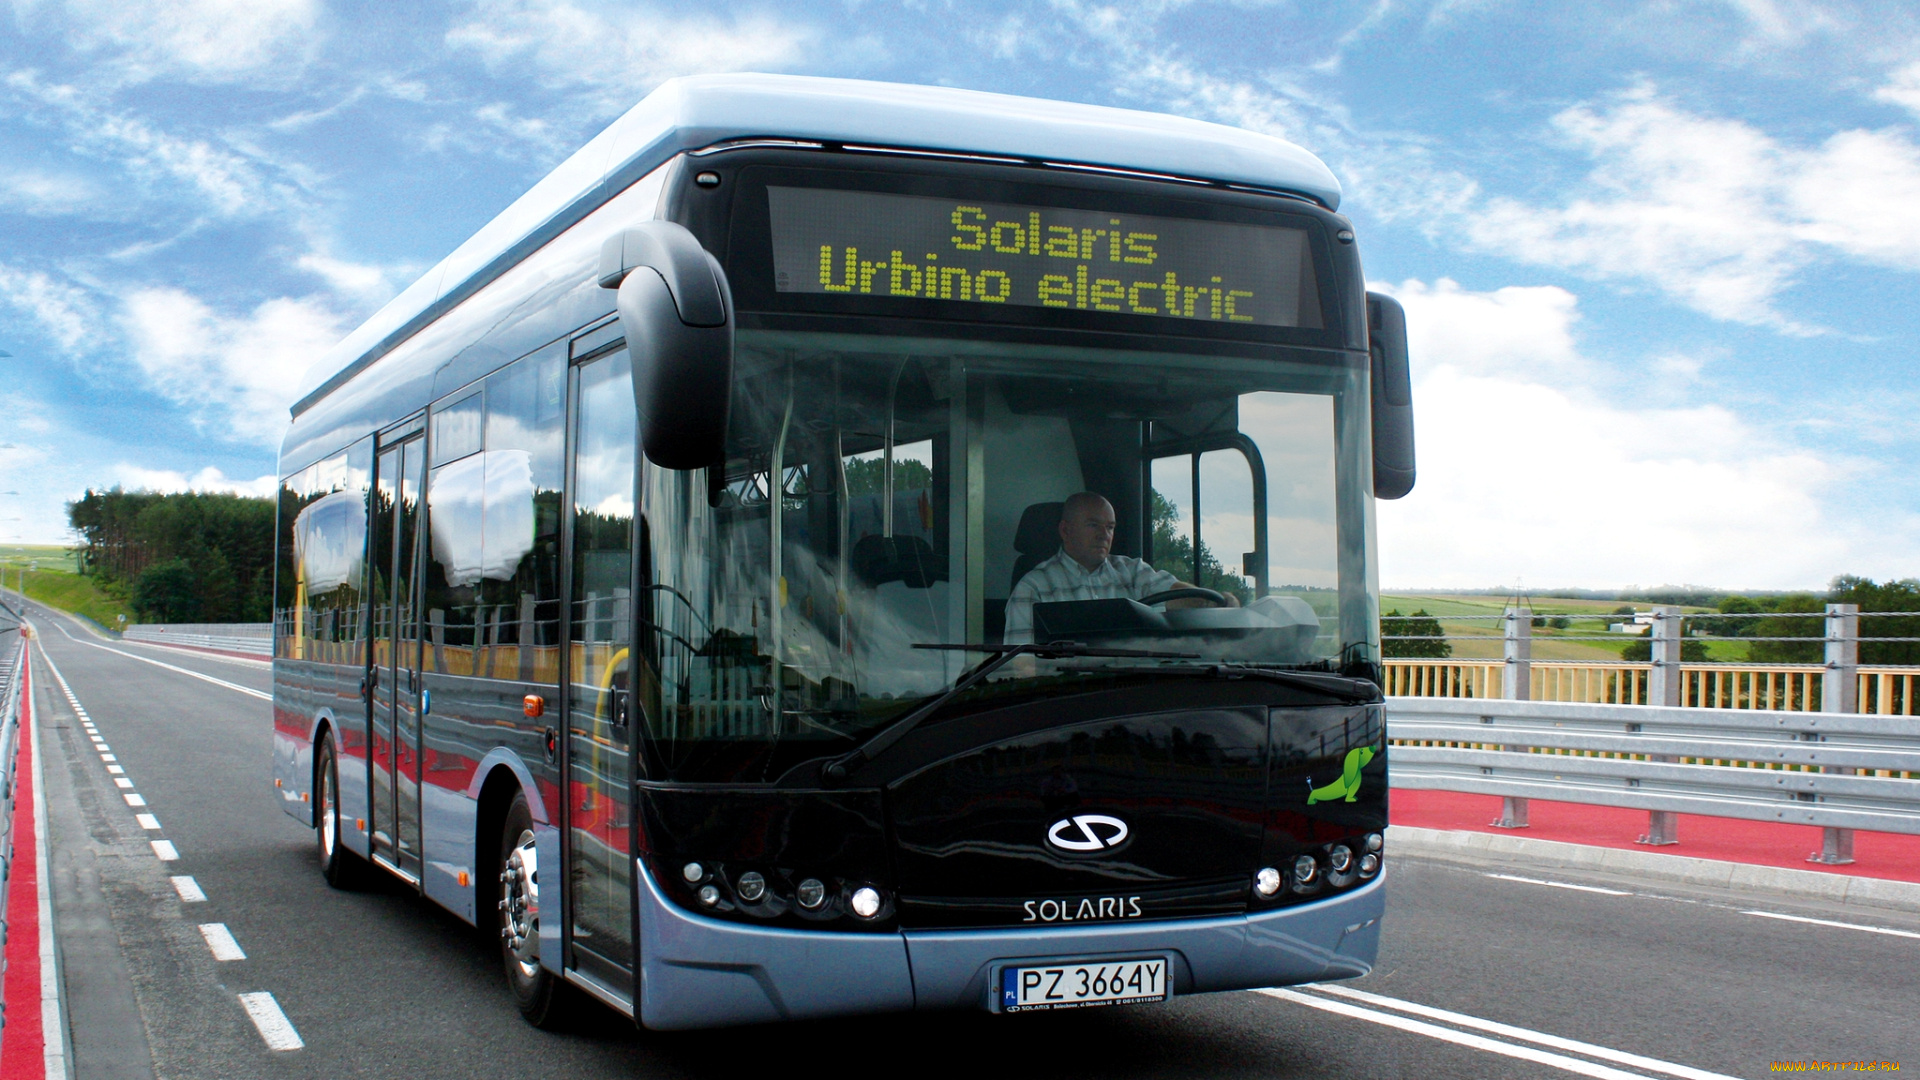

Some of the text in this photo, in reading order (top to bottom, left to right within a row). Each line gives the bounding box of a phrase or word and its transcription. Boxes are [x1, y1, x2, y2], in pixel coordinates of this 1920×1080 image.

[951, 206, 1158, 264] Solaris
[819, 245, 1254, 321] Urbino electric
[1023, 896, 1141, 921] SOLARIS
[1005, 991, 1016, 1000] PL
[1023, 963, 1160, 1001] PZ 3664Y
